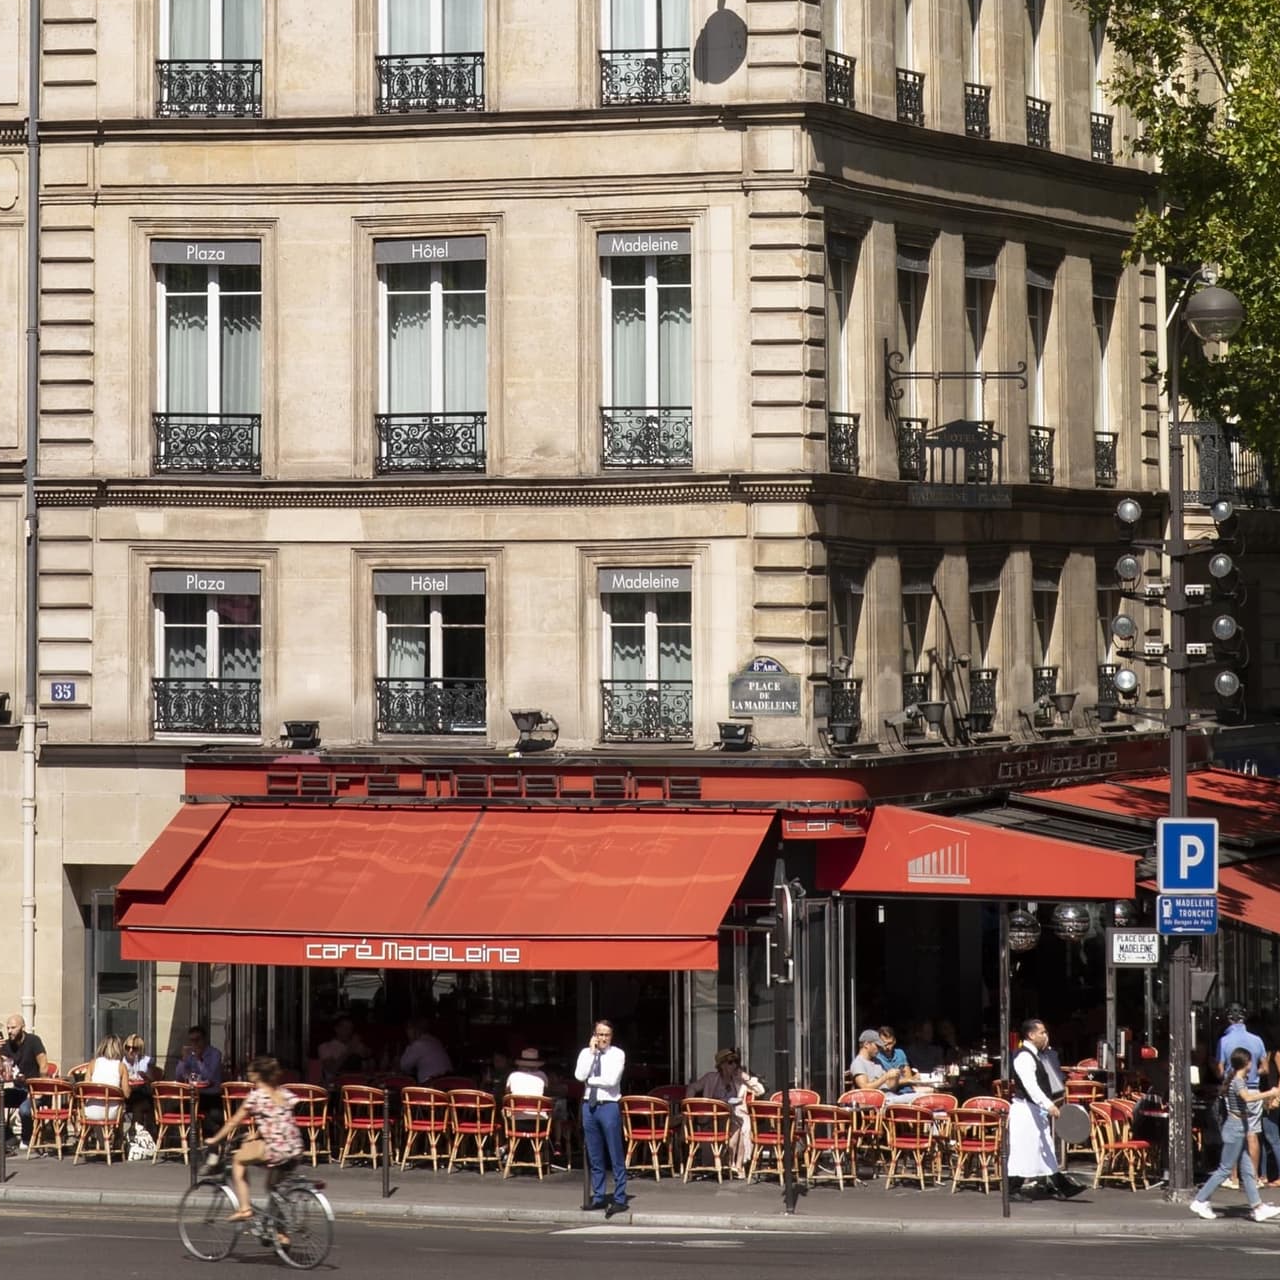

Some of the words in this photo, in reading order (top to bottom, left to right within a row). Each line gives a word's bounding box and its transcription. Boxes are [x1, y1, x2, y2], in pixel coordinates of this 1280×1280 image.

[411, 241, 449, 258] Hôtel
[611, 235, 679, 252] Madeleine
[186, 245, 226, 260] Plaza
[186, 575, 225, 591] Plaza
[411, 574, 449, 591] Hôtel
[611, 572, 679, 590] Madeleine
[55, 684, 71, 700] 35
[748, 681, 781, 691] PLACE
[732, 700, 743, 710] LA
[744, 700, 799, 710] MADELEINE
[1179, 835, 1205, 879] P
[1175, 899, 1214, 907] MADELEINE
[1179, 909, 1214, 918] TRONCHET
[1120, 944, 1153, 953] MADELEINE
